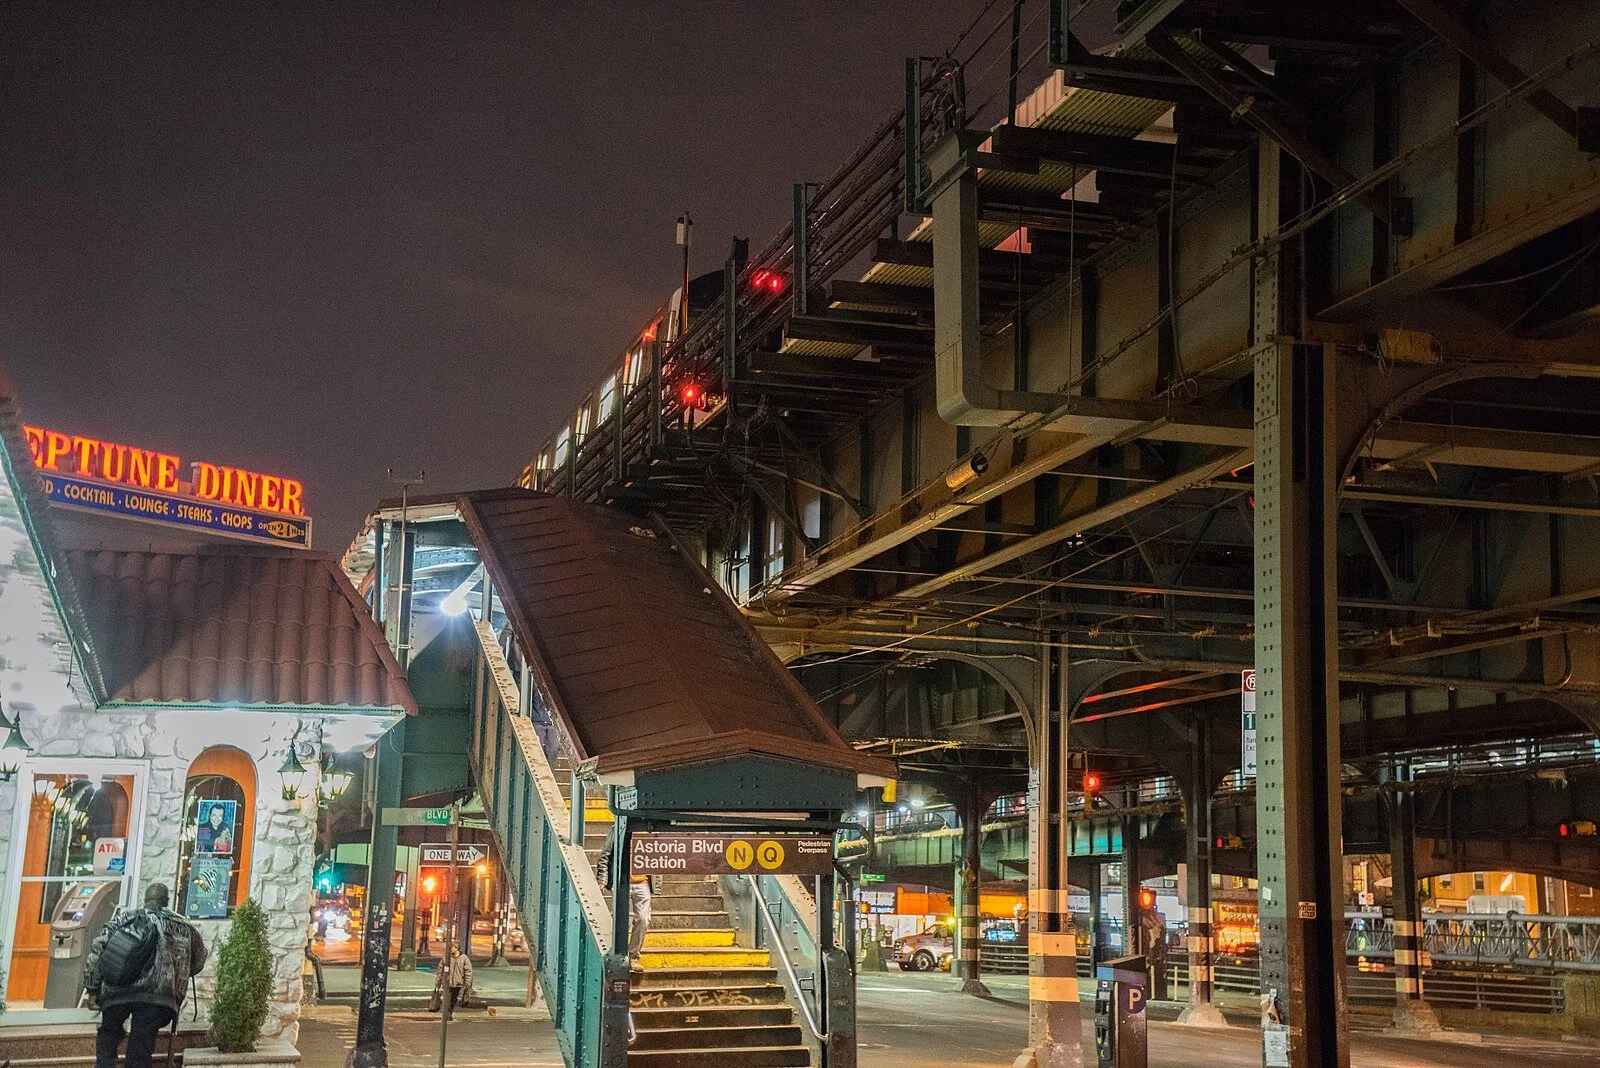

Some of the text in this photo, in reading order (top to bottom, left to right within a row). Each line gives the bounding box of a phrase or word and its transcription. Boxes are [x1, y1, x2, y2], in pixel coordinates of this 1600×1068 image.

[196, 461, 304, 516] DINER
[64, 484, 116, 506] COCKTAIL
[125, 494, 169, 515] LOUNGE
[177, 504, 212, 523] STEAKS
[221, 512, 253, 530] CHOPS
[258, 522, 276, 531] OPEN
[426, 809, 448, 819] BLVD
[634, 840, 723, 853] Astoria Blvd
[429, 851, 478, 860] ONE WAY
[733, 846, 777, 863] N Q
[633, 855, 686, 869] Station
[864, 891, 892, 899] DUKIN
[1129, 988, 1142, 1010] P
